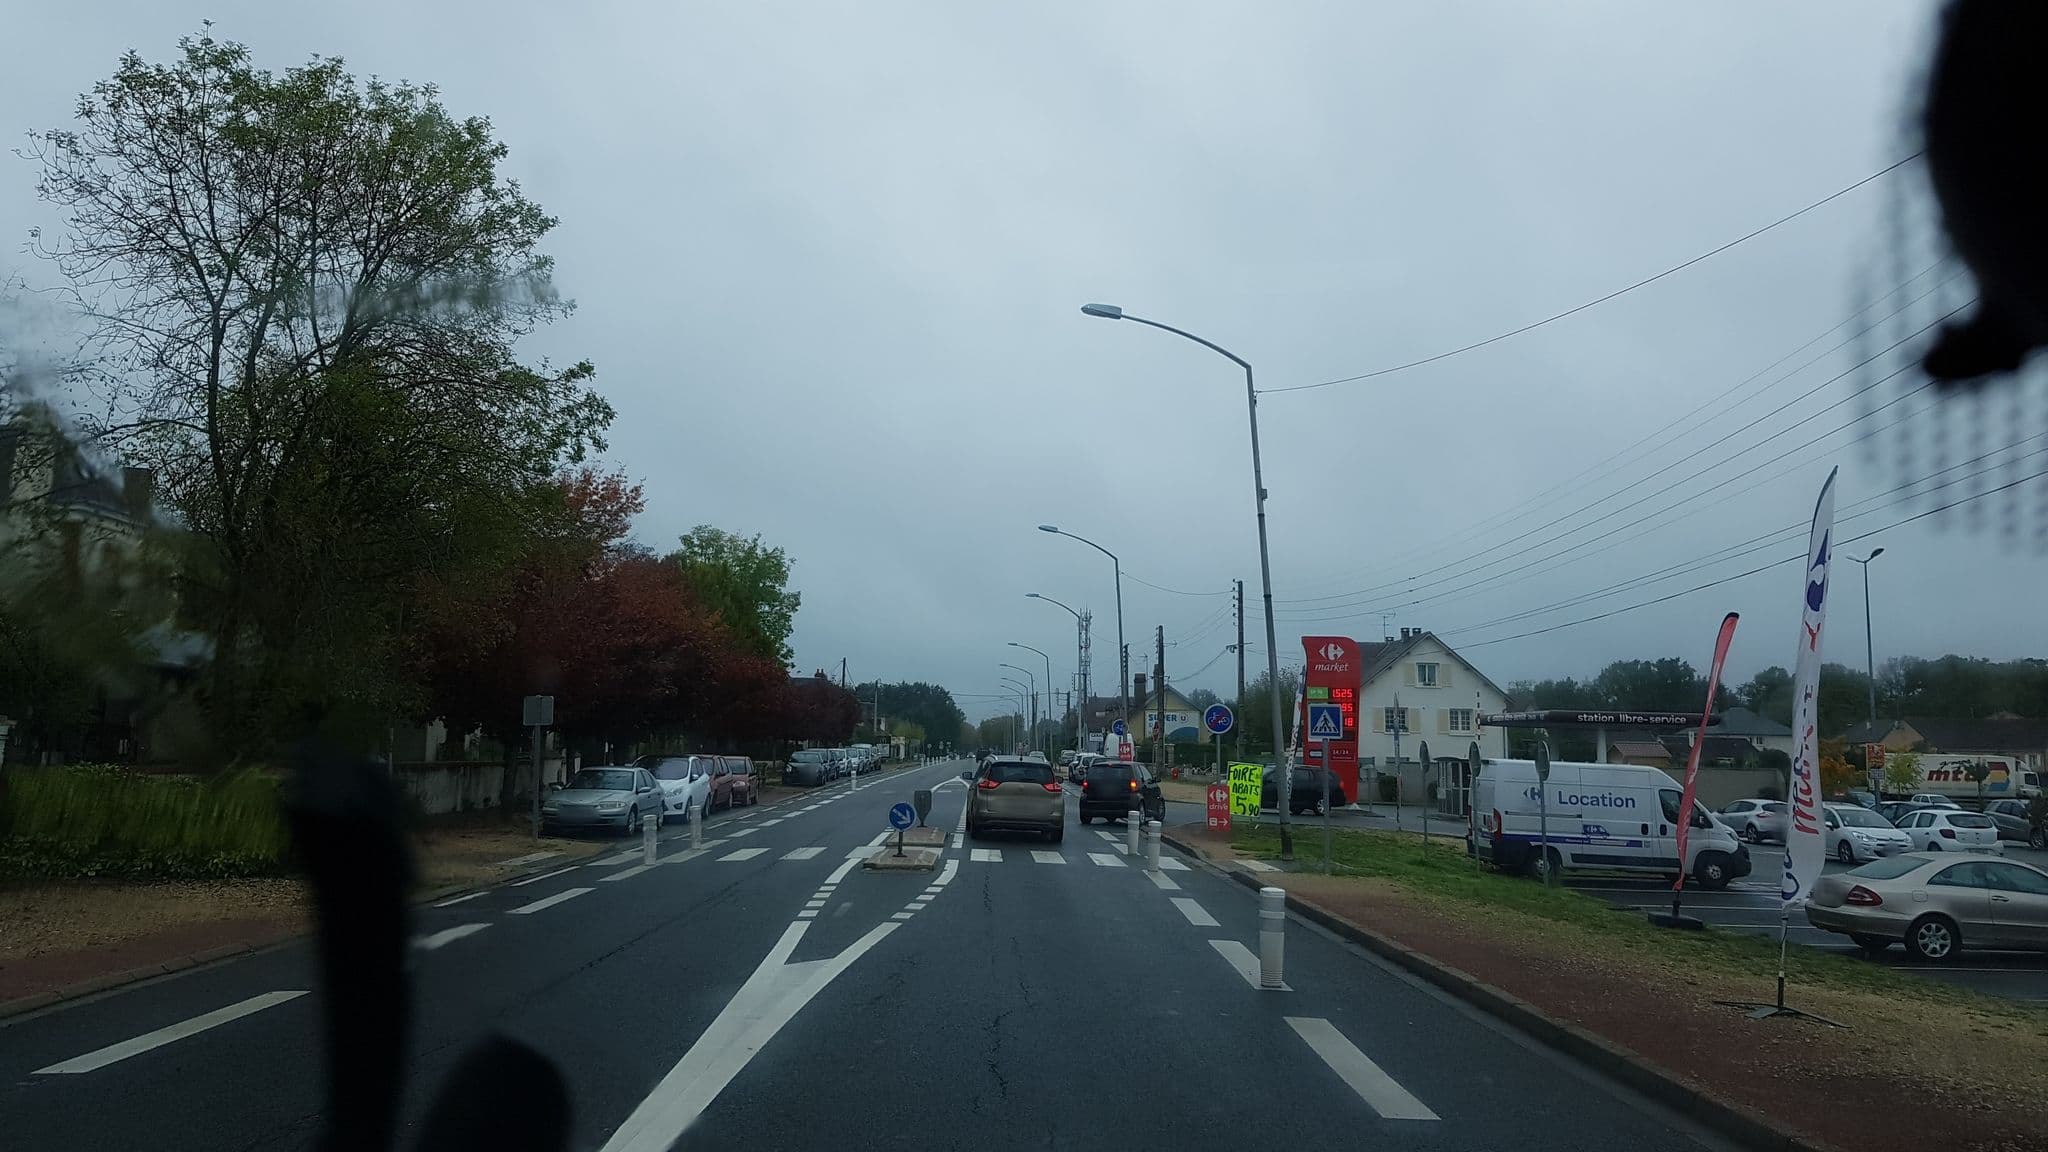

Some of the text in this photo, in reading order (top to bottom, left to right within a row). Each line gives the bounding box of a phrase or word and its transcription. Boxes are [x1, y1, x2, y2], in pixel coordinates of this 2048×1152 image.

[1314, 663, 1350, 672] market
[1148, 714, 1177, 722] SUER
[1577, 713, 1687, 724] station libre-service
[1228, 764, 1258, 783] FOIRE
[1232, 782, 1260, 796] ABATS
[1558, 790, 1636, 809] Location
[1209, 802, 1229, 811] drive
